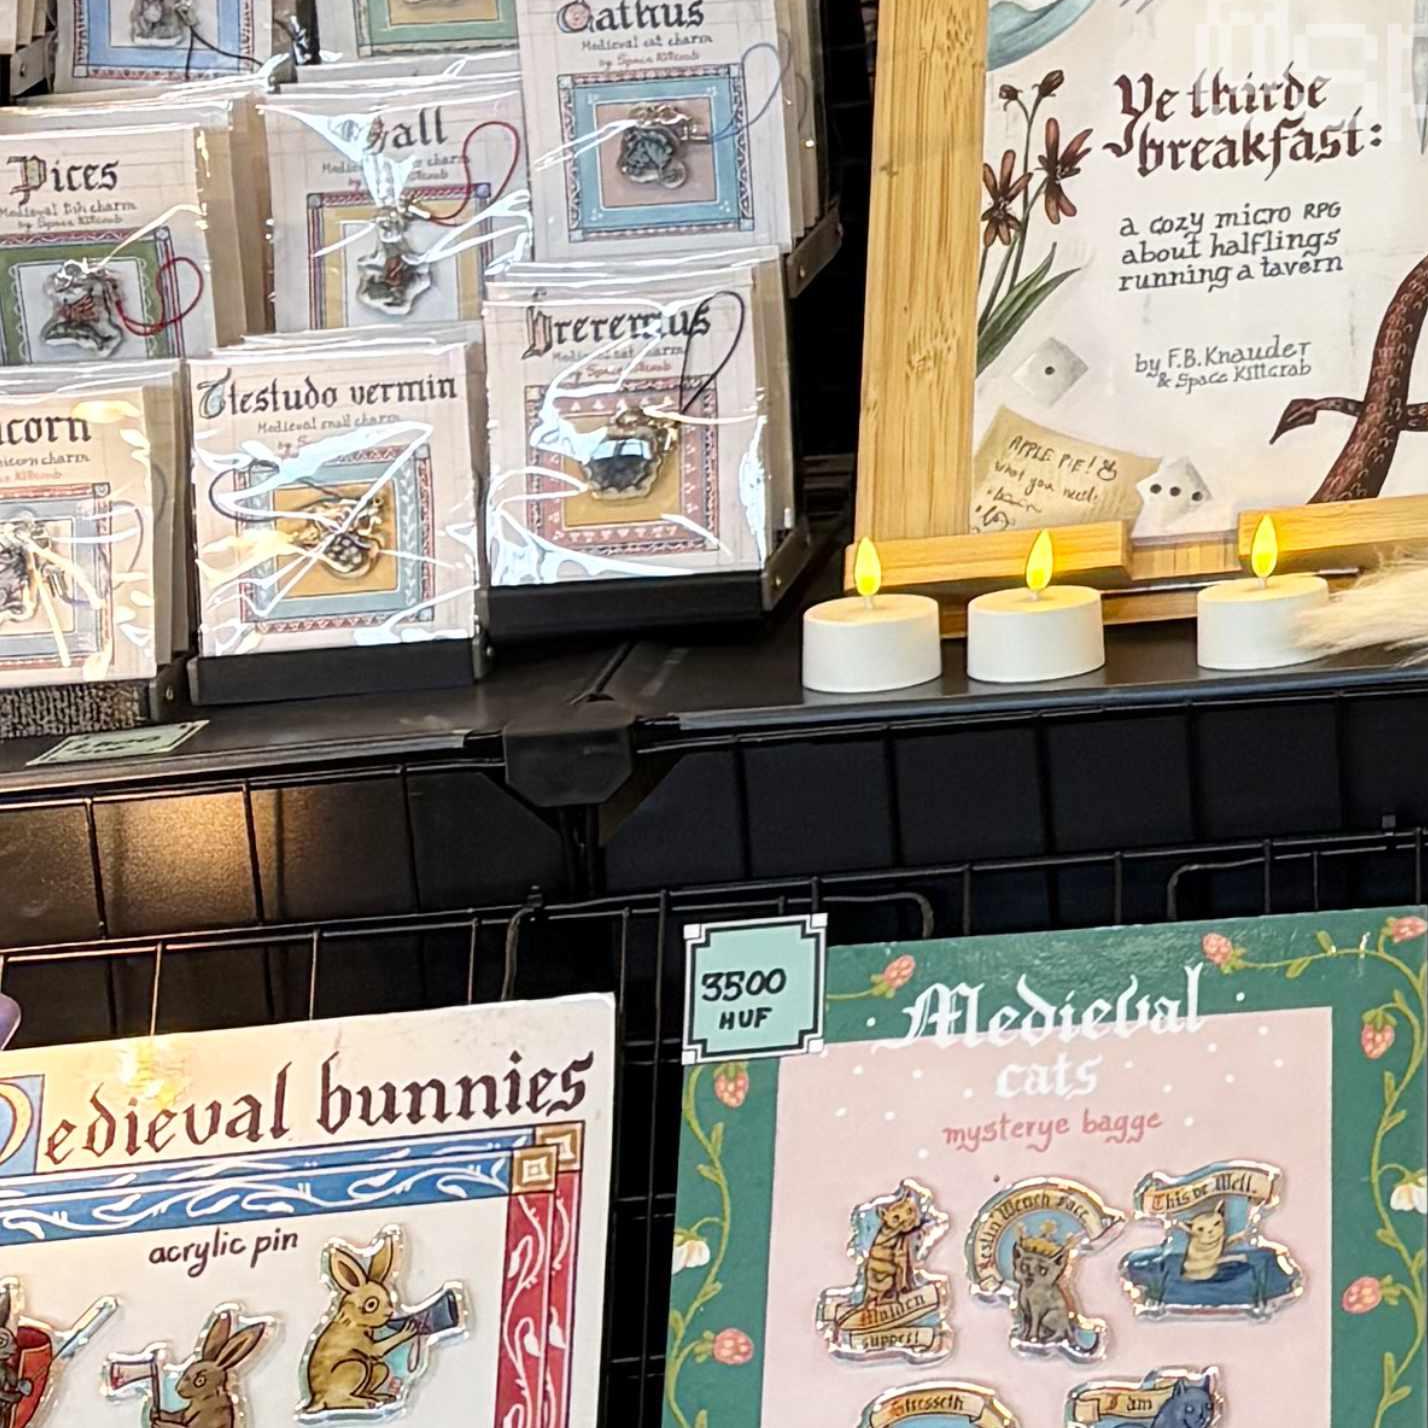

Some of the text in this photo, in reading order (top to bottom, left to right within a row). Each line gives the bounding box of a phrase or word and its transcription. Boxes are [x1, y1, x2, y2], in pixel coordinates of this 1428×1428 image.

[1113, 61, 1328, 125] Ye thirde
[1103, 108, 1385, 180] breakfast:
[6, 154, 119, 206] Pices
[1120, 202, 1342, 249] a cozy micro RPG
[1121, 224, 1341, 266] about halflings
[1118, 252, 1344, 294] running a tavern
[1135, 353, 1159, 378] by
[1206, 335, 1311, 364] Knauder
[350, 374, 457, 405] vermin
[1175, 373, 1229, 394] Space
[1233, 363, 1312, 383] Kittcrab
[1009, 435, 1096, 474] APPLE PIE!
[701, 968, 787, 1002] 3500
[718, 1006, 774, 1030] HUF
[872, 964, 1205, 1053] Medieval
[316, 1050, 593, 1135] bunnies
[995, 1056, 1102, 1099] cats
[942, 1107, 1163, 1151] mysterye bagge
[148, 1227, 299, 1276] acrylic pin
